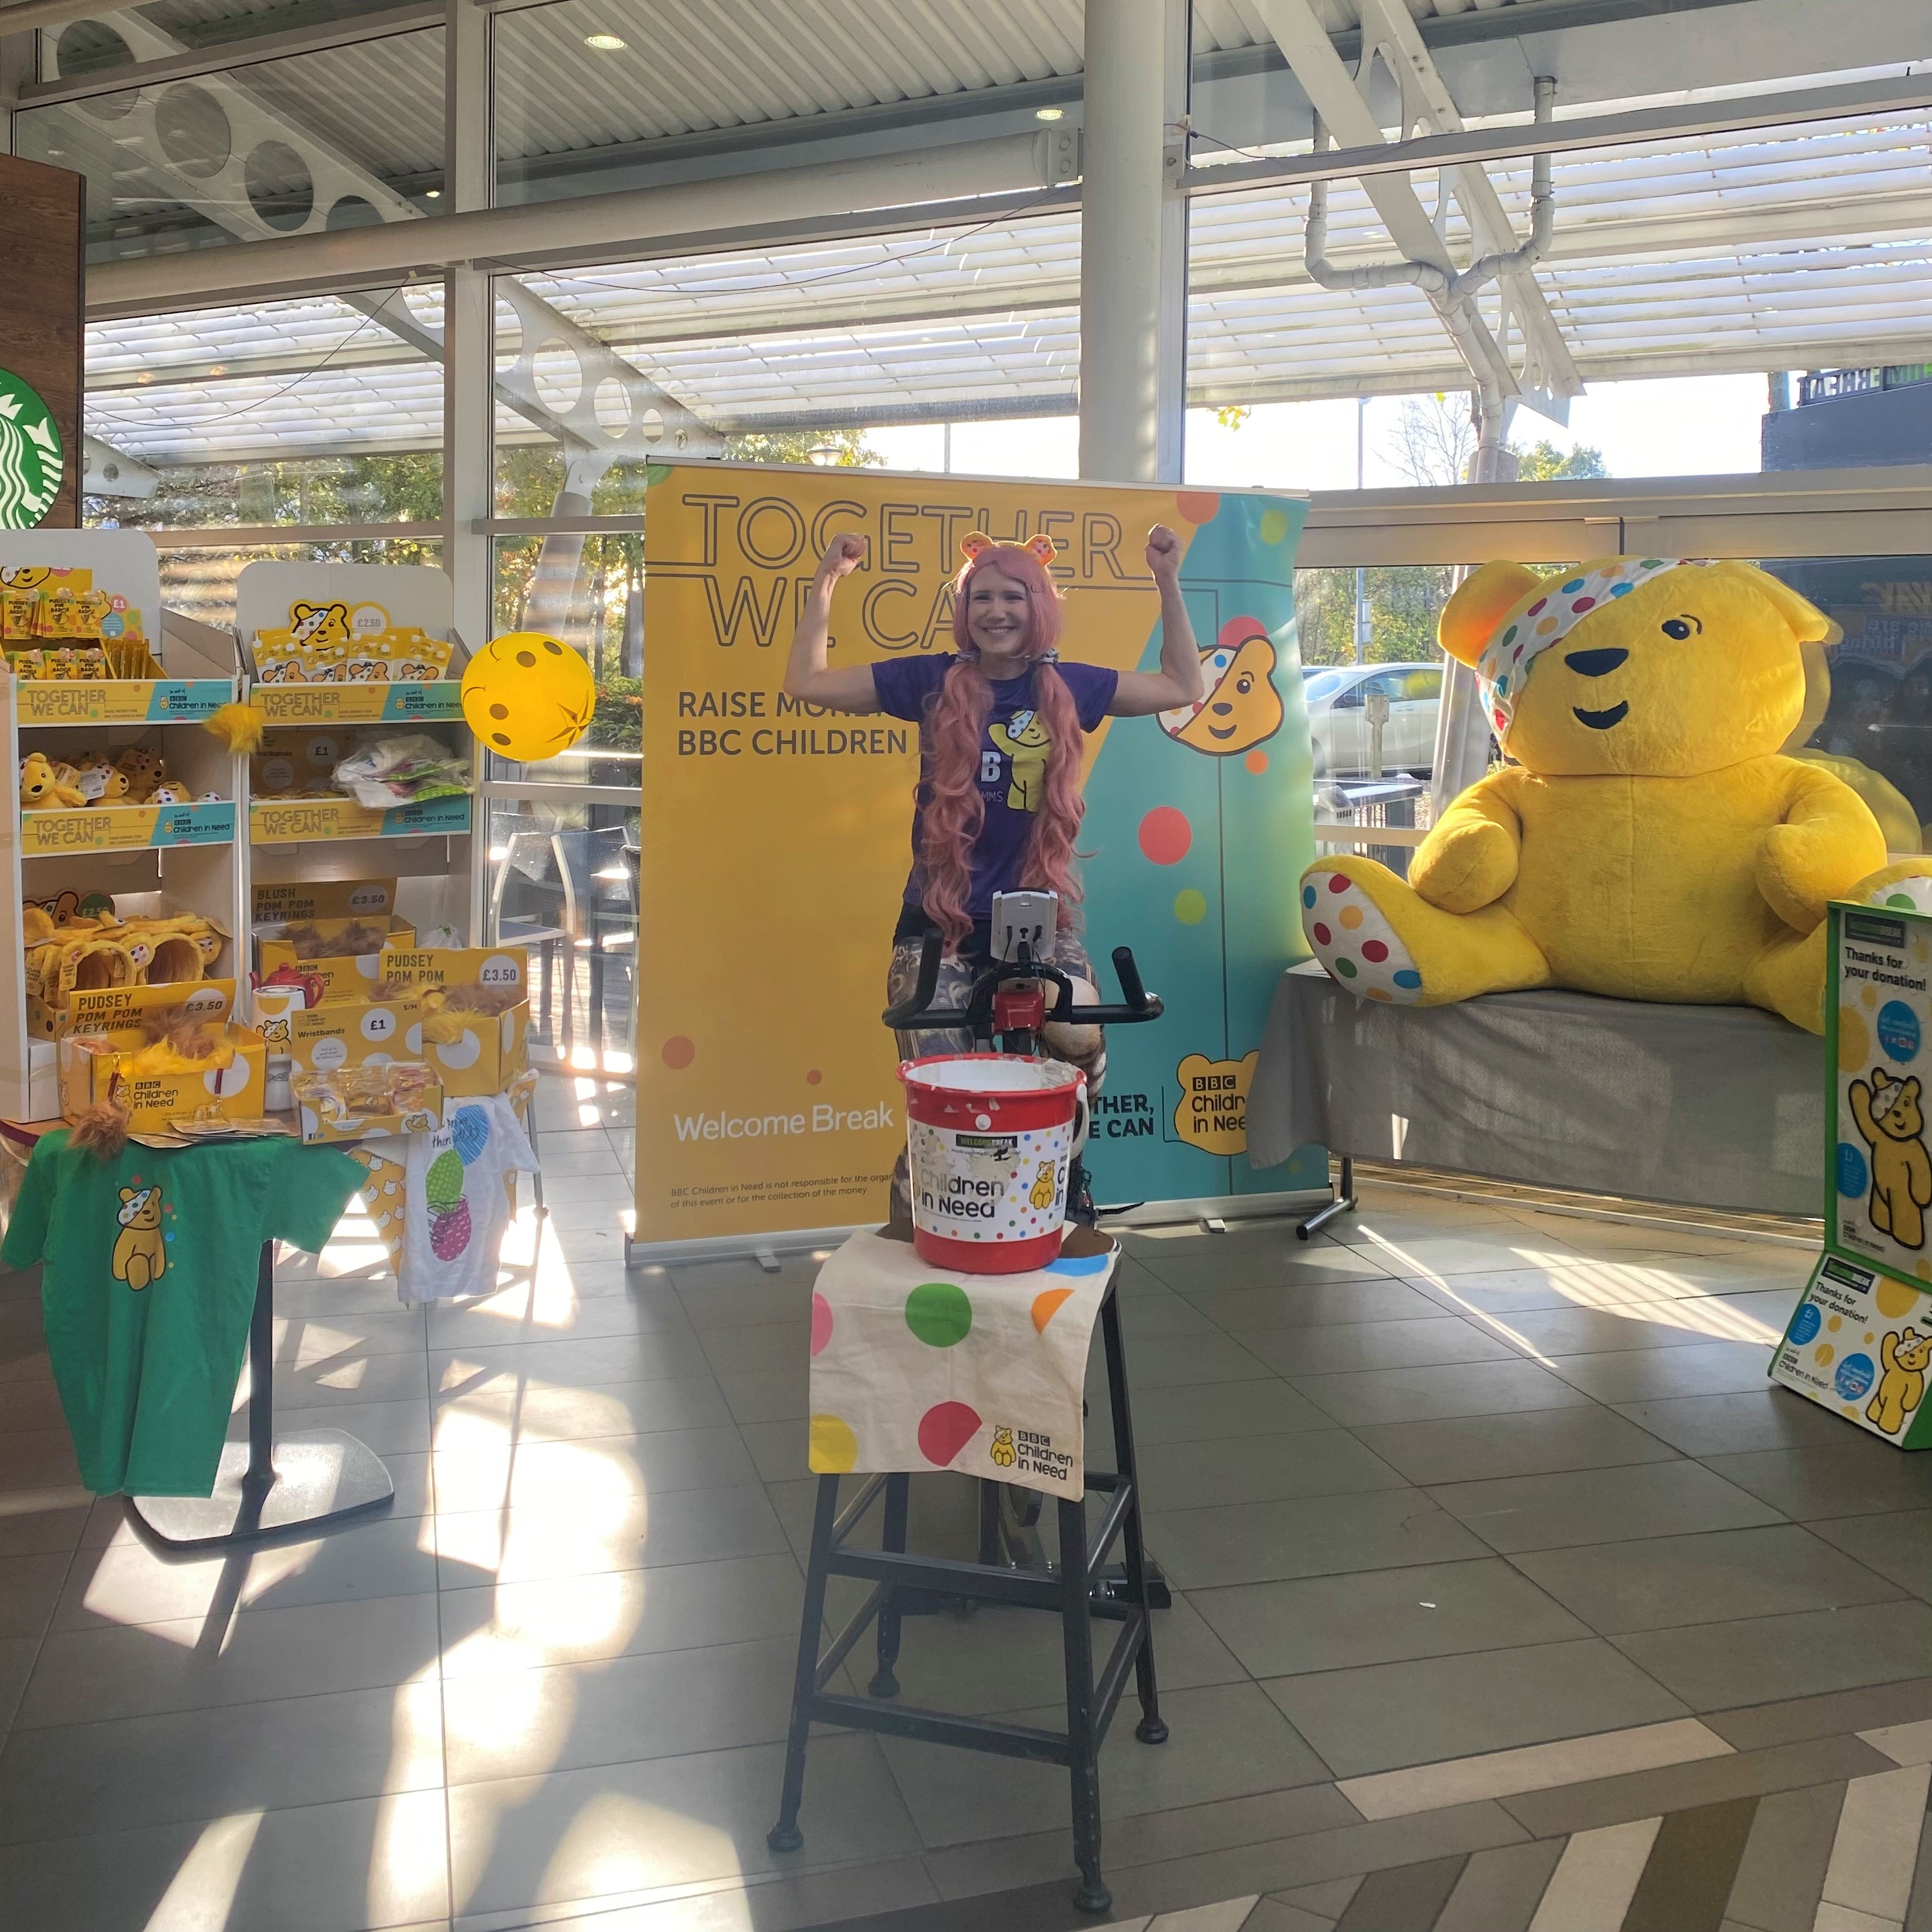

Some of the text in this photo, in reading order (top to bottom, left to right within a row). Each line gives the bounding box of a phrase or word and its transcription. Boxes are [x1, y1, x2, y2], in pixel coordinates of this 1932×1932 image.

[358, 618, 381, 628] £2.50
[28, 690, 106, 703] TOGETHER
[261, 692, 341, 705] TOGETHER
[31, 702, 89, 716] WE CAN
[265, 704, 322, 717] WE CAN
[678, 692, 766, 717] RAISE
[678, 729, 906, 755] BBC CHILDREN
[315, 747, 328, 756] £1
[261, 808, 339, 824] TOGETHER
[33, 817, 111, 833] TOGETHER
[264, 821, 322, 835] WE CAN
[37, 832, 60, 845] WE
[64, 831, 94, 844] CAN
[257, 888, 296, 900] BLUSH
[351, 895, 385, 904] £3.50
[257, 899, 314, 912] POM POM
[255, 910, 315, 921] KEYRINGS
[387, 955, 434, 968] PUDSEY
[1845, 946, 1903, 969] Thanks for
[386, 970, 445, 982] POM POM
[483, 969, 517, 982] £3.50
[1845, 965, 1926, 991] your donation!
[79, 994, 132, 1010] PUDSEY
[76, 1008, 143, 1023] POM POM
[73, 1018, 142, 1034] KEYRINGS
[371, 1020, 386, 1030] £1
[298, 1028, 345, 1038] Wristbands
[136, 1081, 160, 1089] BBC
[1193, 1075, 1236, 1092] BBC
[134, 1089, 178, 1100] Children
[134, 1098, 174, 1109] in Need
[1192, 1093, 1245, 1113] Childr
[674, 1101, 894, 1142] Welcome Break
[1107, 1117, 1154, 1138] CAN
[1193, 1115, 1245, 1133] in Nee
[671, 1188, 689, 1197] BBC
[692, 1186, 728, 1195] Children
[741, 1182, 764, 1191] Need
[775, 1180, 789, 1189] not
[791, 1177, 838, 1189] responsible
[671, 1200, 680, 1208] of
[768, 1191, 809, 1200] collection
[823, 1188, 836, 1197] the
[838, 1187, 867, 1196] money
[921, 1189, 933, 1210] in
[939, 1196, 995, 1218] Need
[1815, 1281, 1857, 1306] Thanks for
[1808, 1293, 1829, 1306] your
[1829, 1301, 1869, 1324] donation!
[1018, 1430, 1050, 1447] BBC
[1018, 1443, 1073, 1467] Children
[1018, 1457, 1067, 1481] in Need
